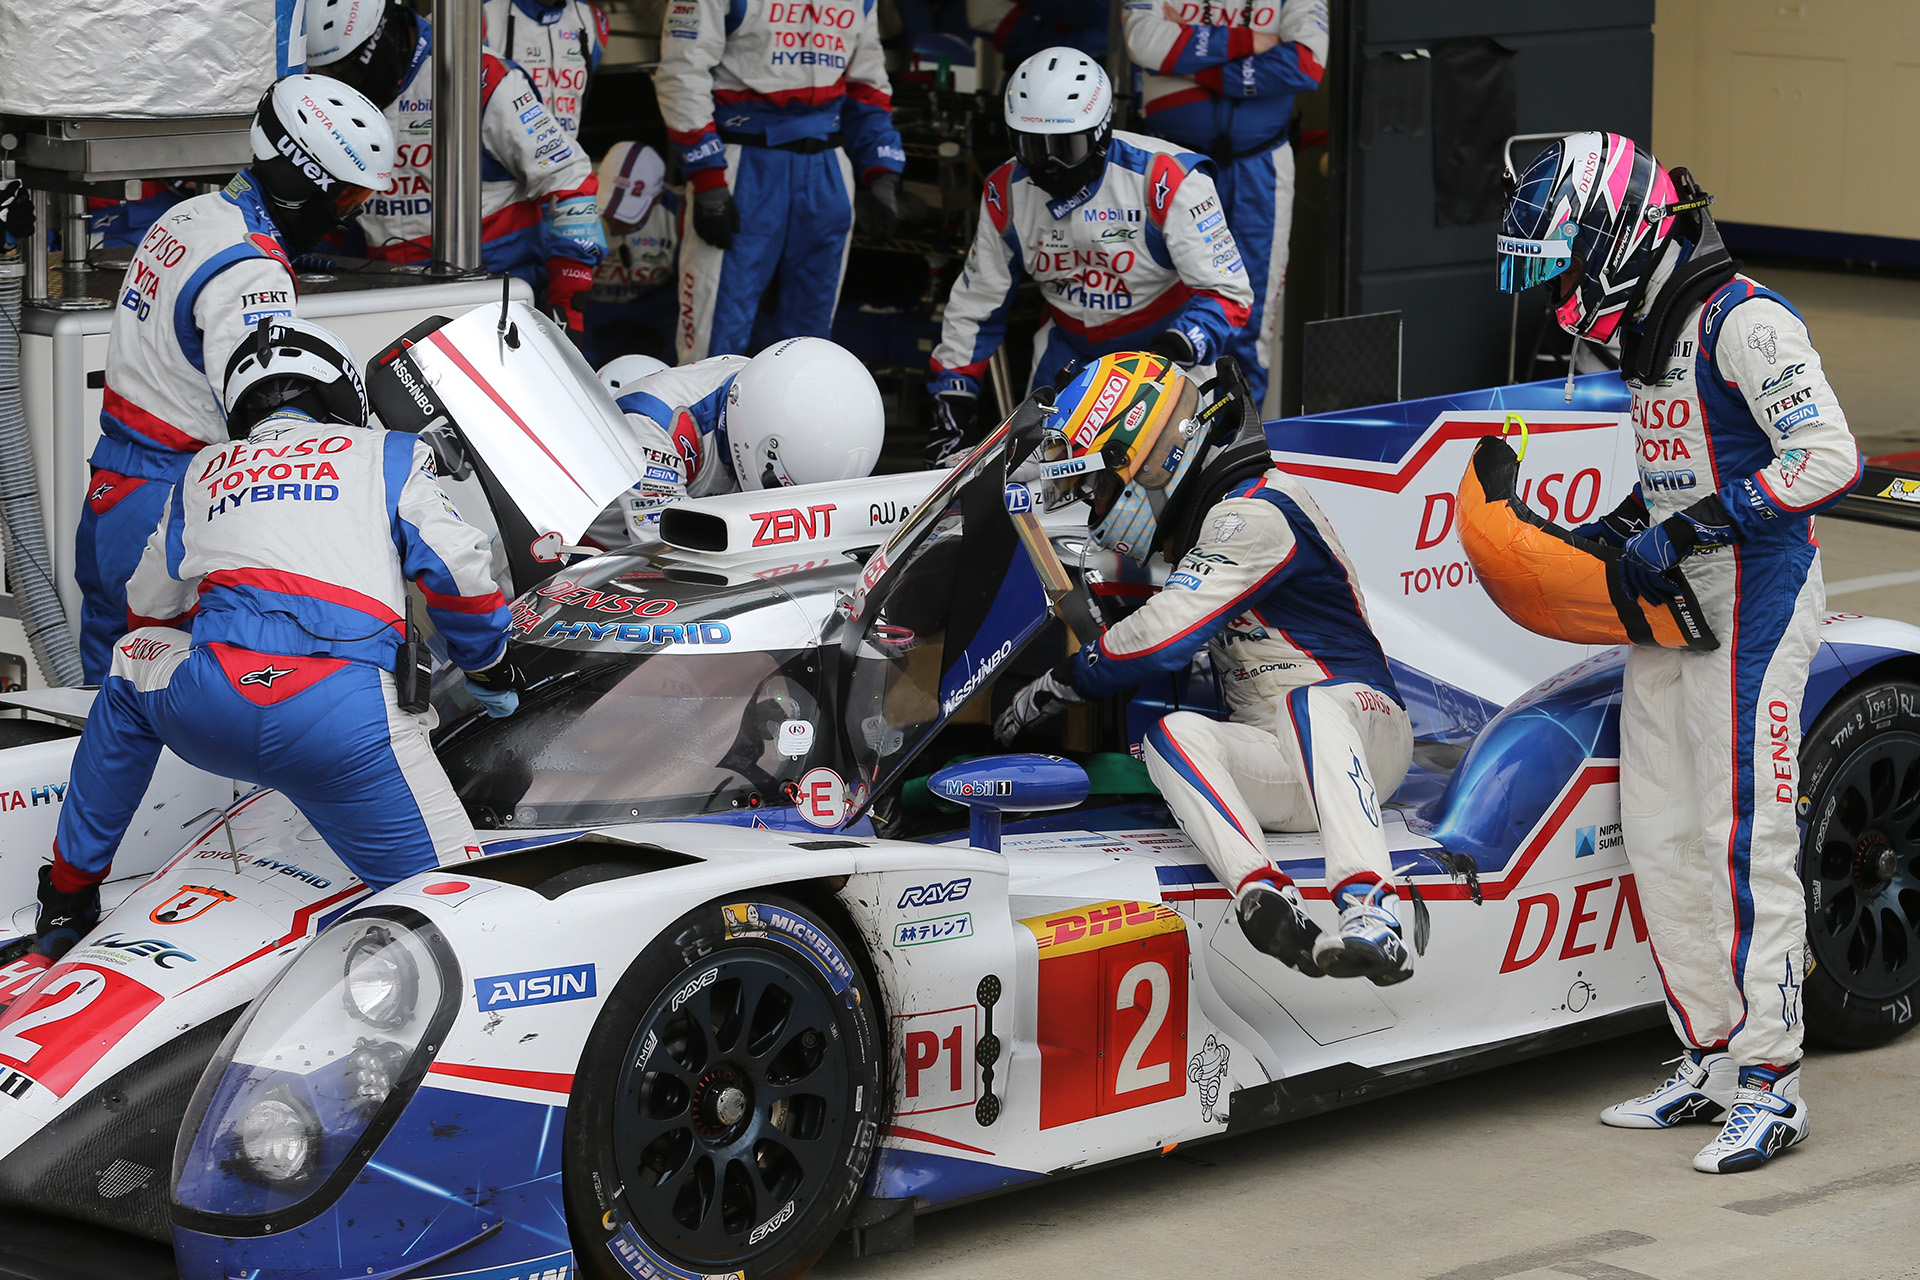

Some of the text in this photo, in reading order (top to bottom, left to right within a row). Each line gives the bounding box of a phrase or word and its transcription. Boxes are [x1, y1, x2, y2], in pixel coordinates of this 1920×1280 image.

[344, 1, 360, 37] TOYOTA
[769, 3, 855, 29] DENSO
[775, 31, 846, 52] TOYOTA
[771, 51, 846, 69] HYBRID
[531, 67, 586, 91] ENSO
[300, 95, 334, 131] TOYOTA
[398, 101, 432, 113] Mobil
[1083, 86, 1102, 115] TOYOTA
[1020, 116, 1044, 124] TOYOTA
[276, 134, 336, 193] uvex
[331, 128, 367, 172] HYBRID
[631, 180, 645, 196] 2
[1578, 151, 1598, 194] DENSO
[1053, 195, 1081, 219] Mobil
[1084, 209, 1140, 223] Mobil 1
[1036, 250, 1135, 274] DENSO
[241, 291, 288, 310] JTEKT
[680, 273, 695, 350] DENSO
[1682, 341, 1693, 357] 1
[312, 365, 328, 376] ELLEN
[1762, 363, 1806, 391] WEC
[1079, 377, 1124, 447] DENSO
[1126, 404, 1143, 427] BELL
[1631, 395, 1691, 429] ENSO
[1765, 387, 1812, 423] JTEKT
[1778, 406, 1815, 430] AISIN
[197, 435, 354, 484] DENSO
[642, 446, 681, 468] TEKT
[1172, 449, 1184, 461] 51
[207, 460, 340, 499] TOYOTA
[647, 468, 676, 480] ISIN
[207, 484, 340, 523] HYBRID
[1007, 489, 1027, 510] ZF
[1415, 468, 1602, 550] DSO
[749, 503, 837, 547] ZENT
[1401, 561, 1479, 595] TOYOT
[537, 580, 678, 618] DENSO
[119, 638, 171, 661] DENSO
[545, 620, 732, 646] HYBRID
[1768, 700, 1793, 804] DENSO
[811, 781, 834, 817] E
[945, 779, 1012, 797] Mobil 1
[1815, 795, 1837, 854] RAYS
[1102, 845, 1134, 853] NPR
[192, 850, 332, 889] TOYOTA HYBRID
[897, 878, 972, 909] RAYS
[900, 917, 968, 942] 林テレンプ
[1046, 901, 1156, 945] DHL
[1499, 874, 1649, 974] DEN
[90, 932, 197, 970] WEC
[770, 913, 850, 978] MICHELIN
[487, 970, 588, 1005] AISIN
[671, 967, 719, 1012] RAYS
[0, 969, 106, 1064] 2
[1115, 961, 1171, 1095] 2
[905, 1026, 963, 1098] P1
[750, 1200, 795, 1245] RAYS
